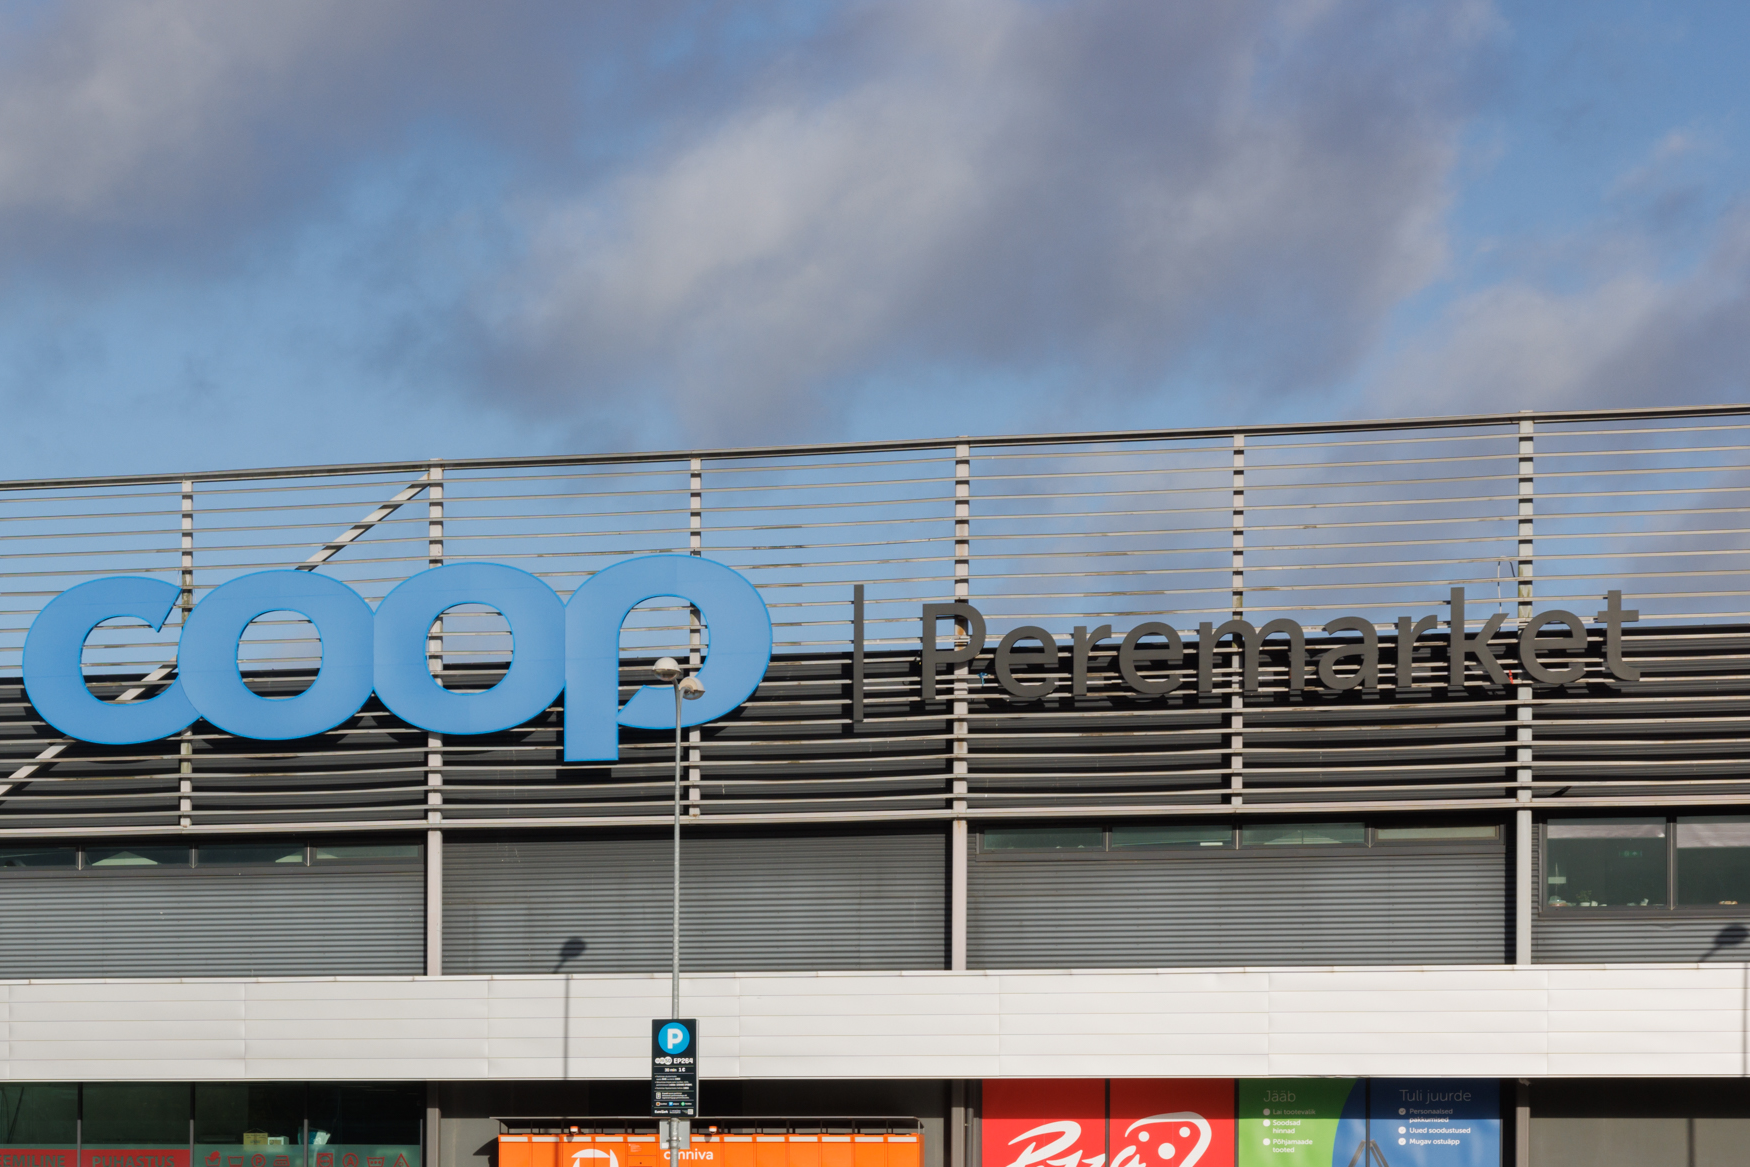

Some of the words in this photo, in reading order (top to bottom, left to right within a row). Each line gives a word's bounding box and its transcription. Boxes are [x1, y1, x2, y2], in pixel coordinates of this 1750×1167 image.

[921, 586, 1641, 702] Peremarket
[22, 554, 773, 762] coop
[667, 1028, 683, 1049] P
[1263, 1089, 1296, 1102] Jääb
[1399, 1089, 1423, 1102] Tuli
[1425, 1089, 1472, 1104] juurde
[1409, 1116, 1449, 1124] pakkumised
[1272, 1138, 1313, 1147] Põhjamaade
[1409, 1138, 1431, 1146] Mugav
[1432, 1138, 1460, 1146] ostuäpp
